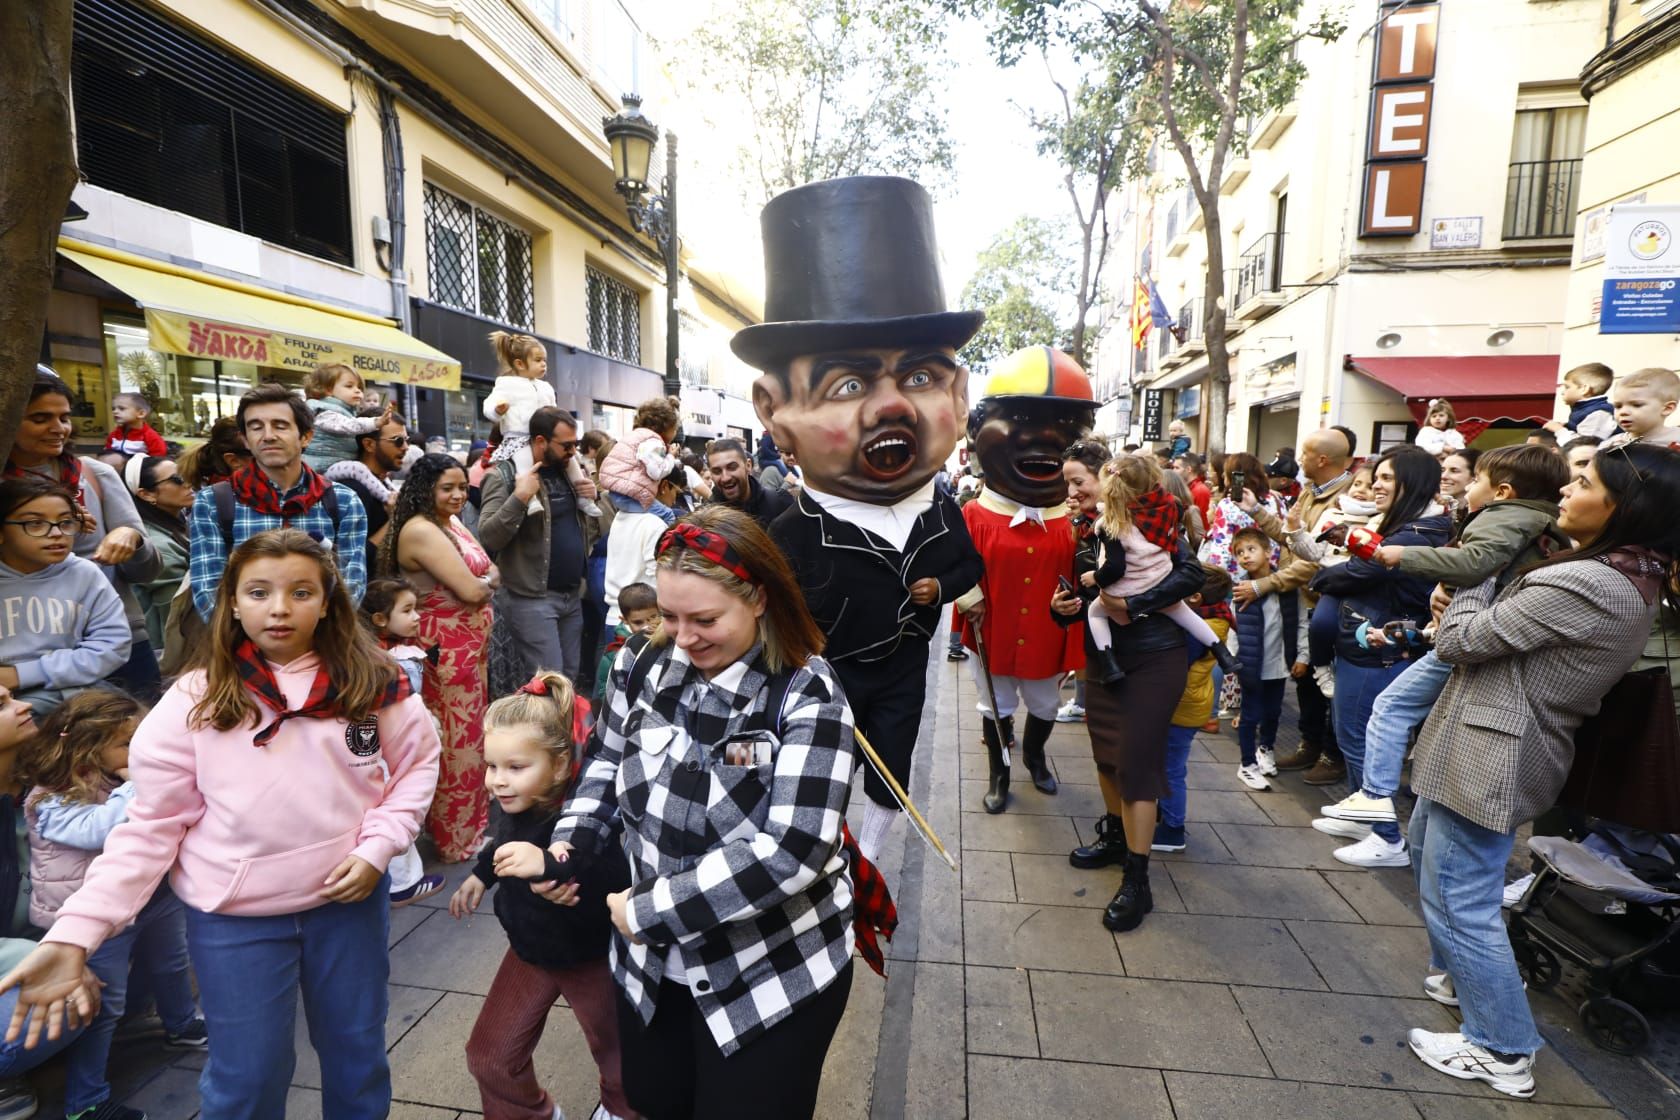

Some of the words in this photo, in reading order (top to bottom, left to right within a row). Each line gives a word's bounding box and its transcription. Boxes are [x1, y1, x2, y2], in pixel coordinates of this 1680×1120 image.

[1371, 11, 1435, 228] TEL
[1434, 232, 1448, 242] SAN
[1451, 232, 1479, 242] VALERO
[284, 337, 333, 353] FRUTAS
[301, 350, 319, 360] DE
[353, 355, 400, 374] REGALOS
[1147, 391, 1160, 433] HOTEL
